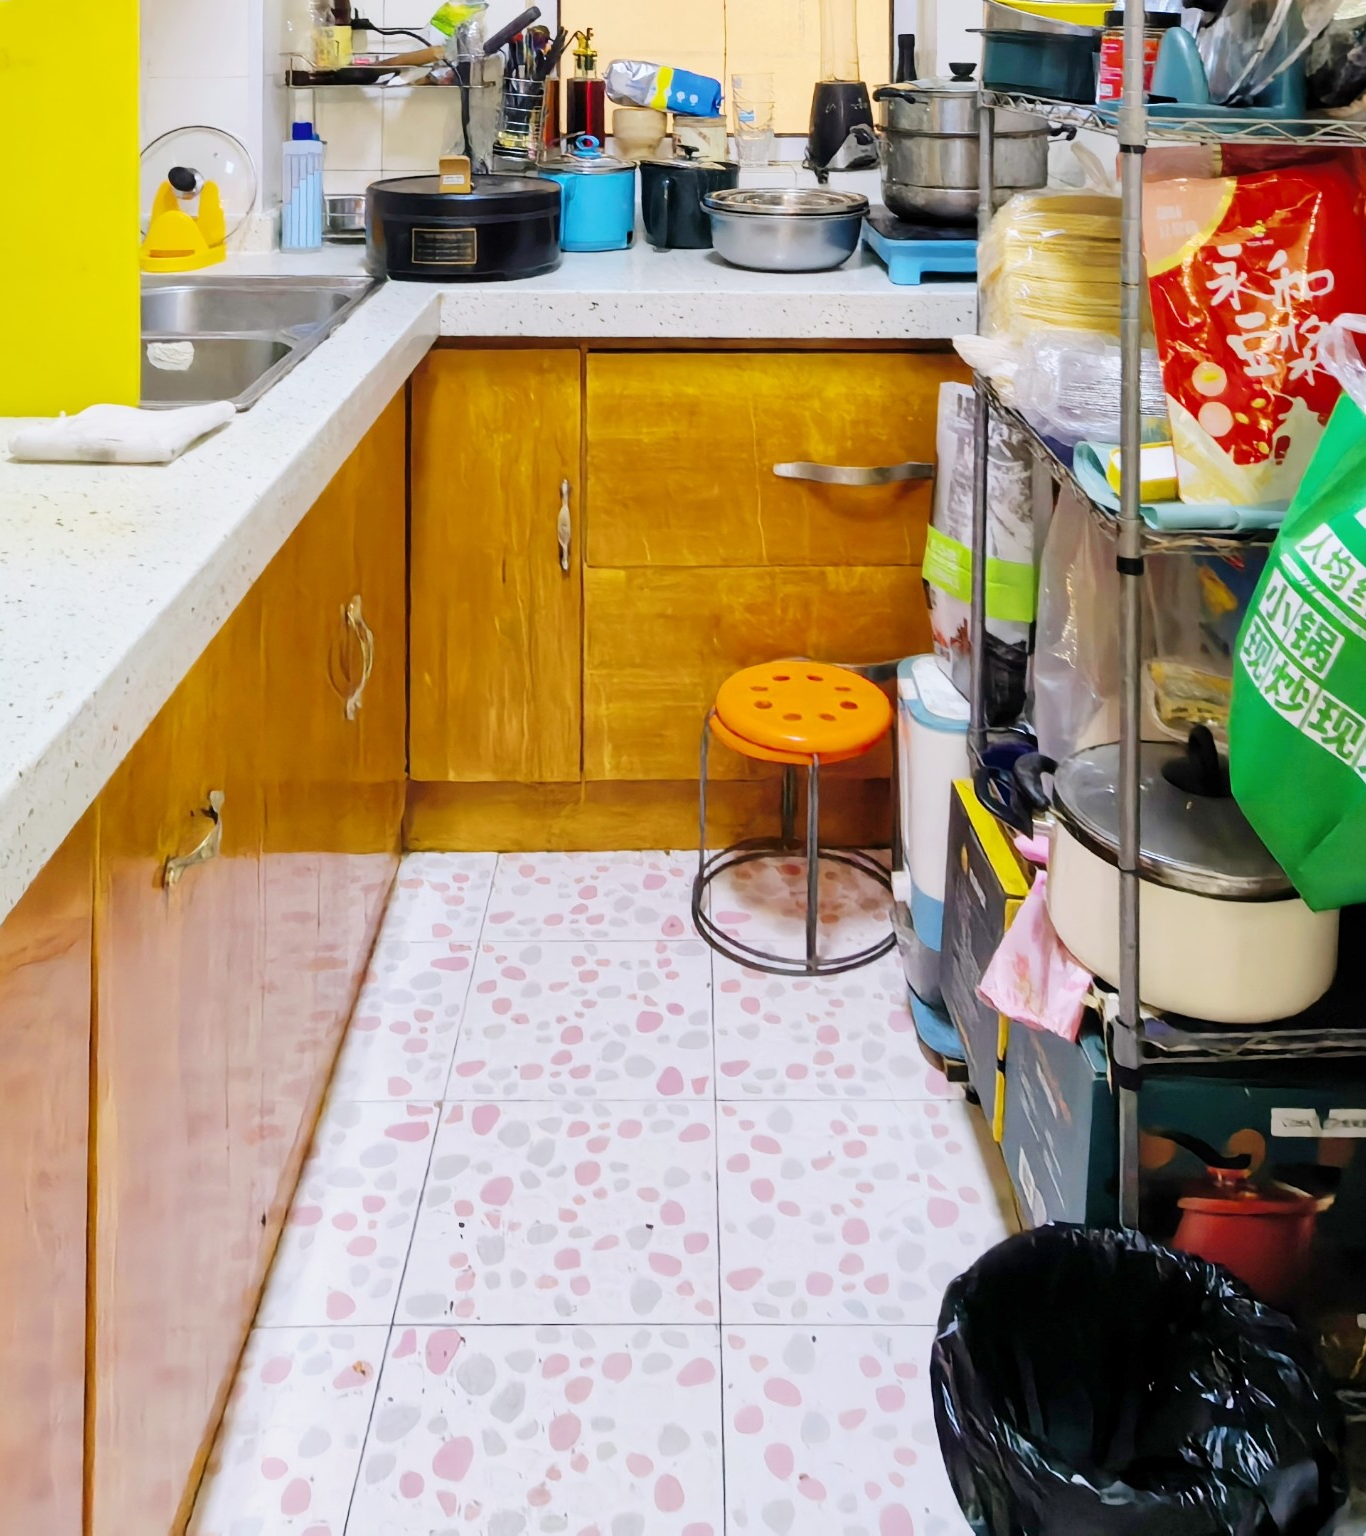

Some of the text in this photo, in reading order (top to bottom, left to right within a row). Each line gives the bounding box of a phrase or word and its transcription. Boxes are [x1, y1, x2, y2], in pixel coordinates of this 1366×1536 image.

[1206, 243, 1335, 310] 永和
[1226, 311, 1336, 386] 豆浆
[1265, 581, 1335, 673] 小锅
